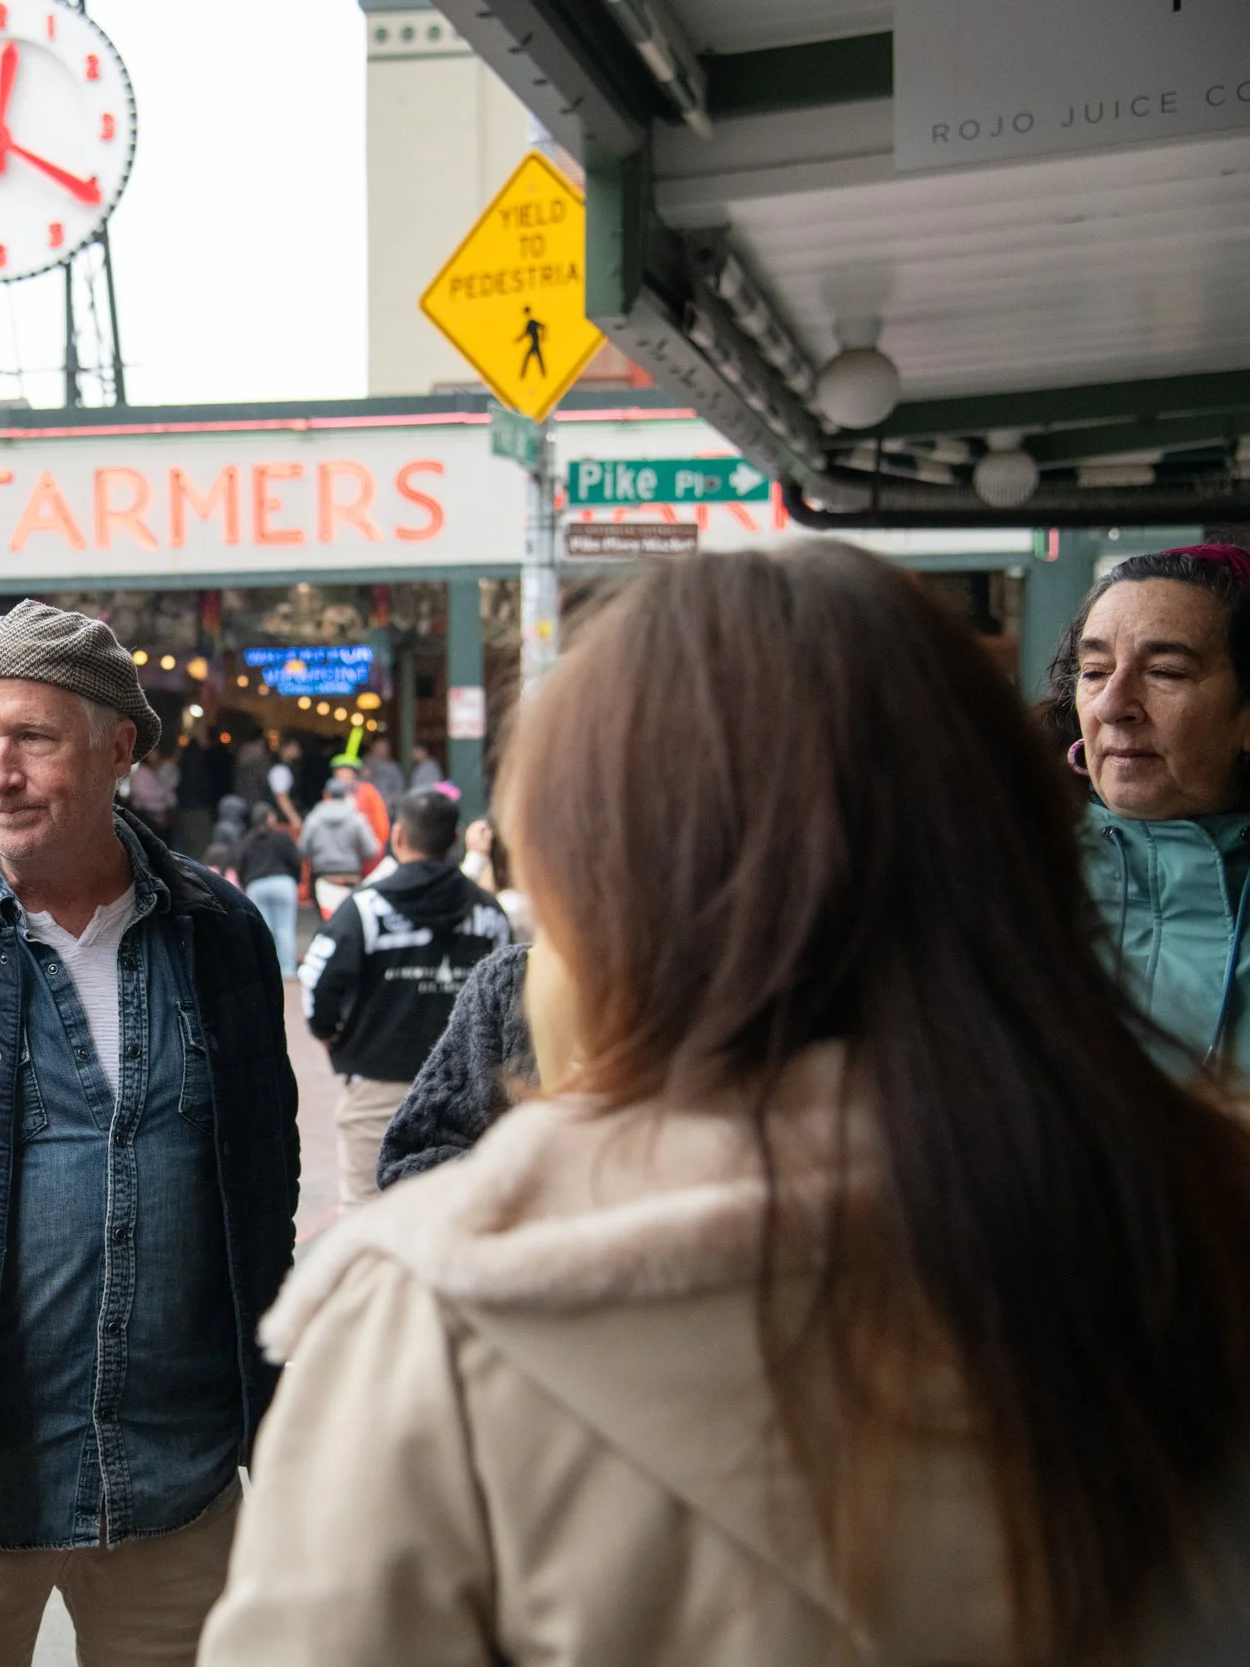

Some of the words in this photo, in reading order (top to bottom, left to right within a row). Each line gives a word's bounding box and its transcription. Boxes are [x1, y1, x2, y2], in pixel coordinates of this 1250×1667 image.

[931, 111, 1034, 143] ROJO
[1060, 91, 1178, 127] JUICE
[499, 199, 567, 228] YIELD
[519, 234, 546, 260] TO
[450, 262, 579, 300] PEDESTRIA
[577, 462, 658, 500] Pike
